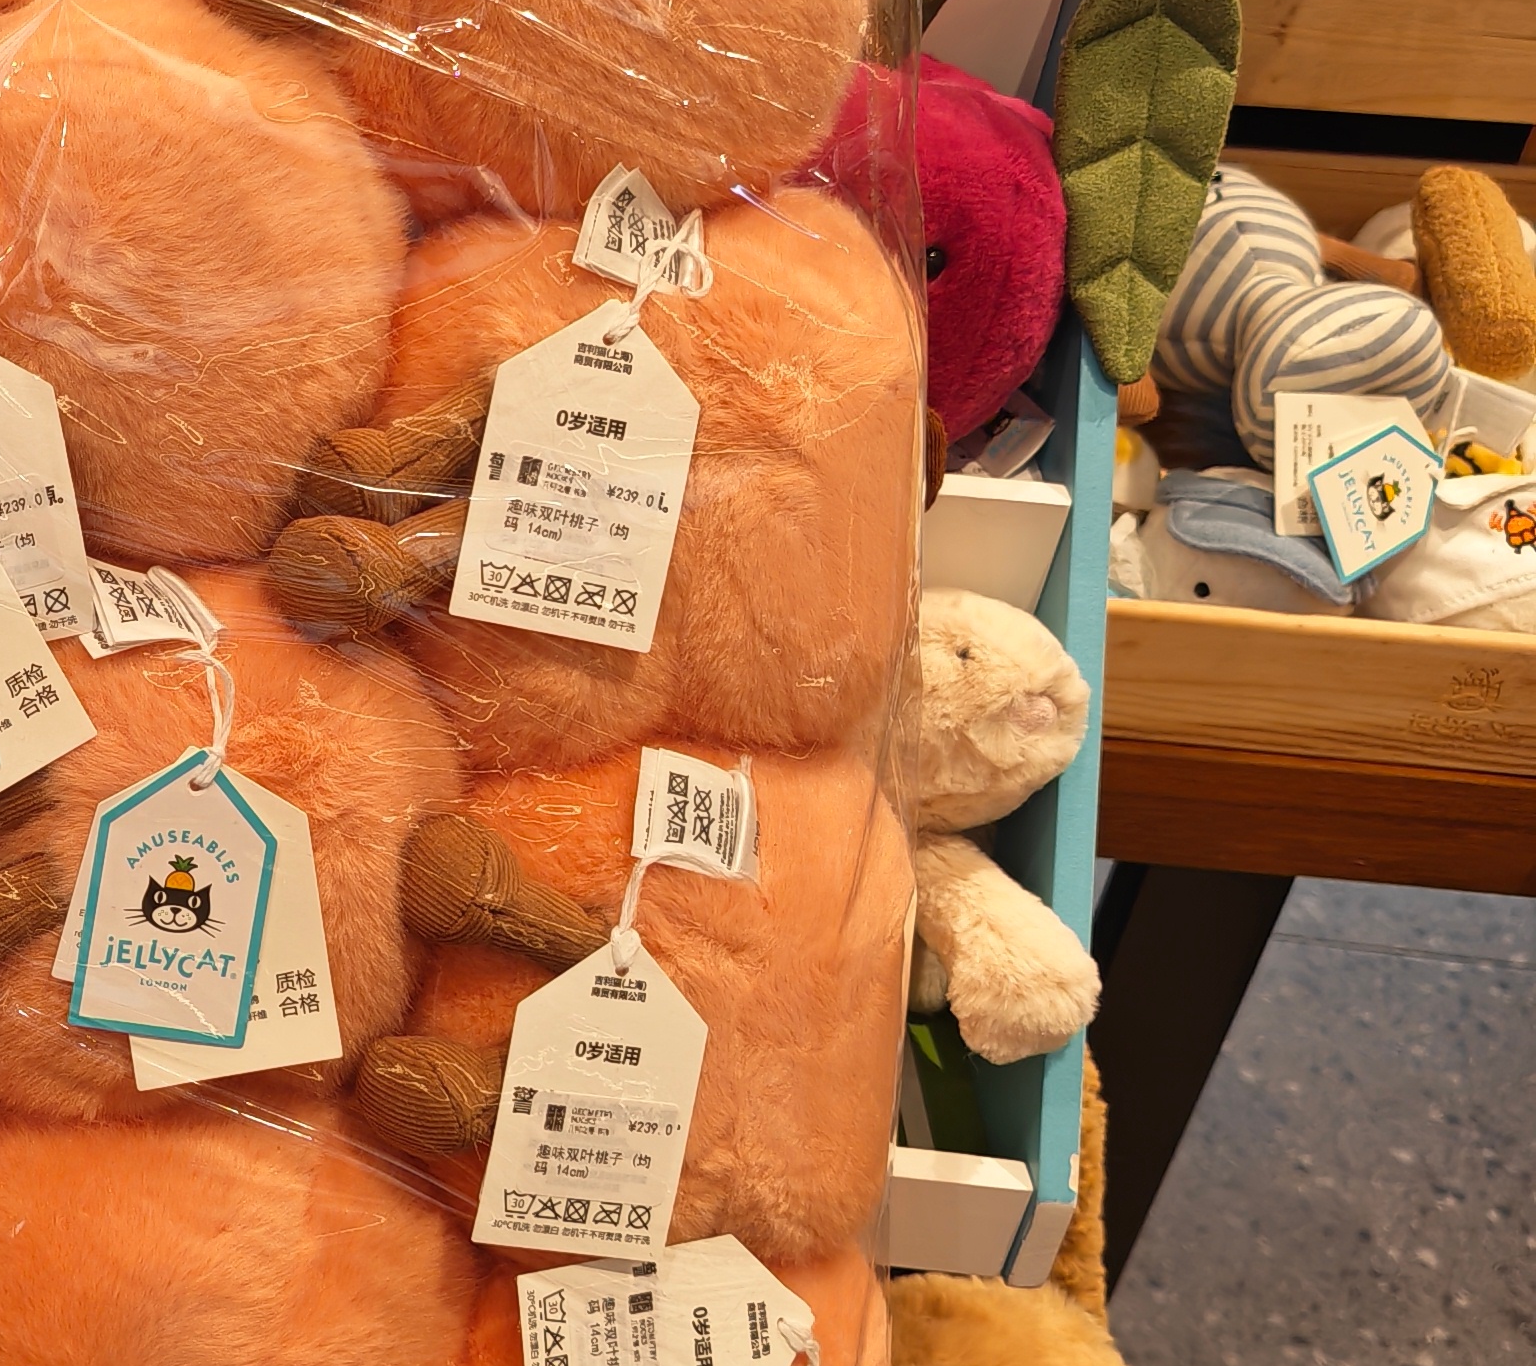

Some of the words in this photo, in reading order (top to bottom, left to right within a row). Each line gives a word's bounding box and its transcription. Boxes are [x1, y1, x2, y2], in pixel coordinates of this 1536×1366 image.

[556, 409, 626, 441] 0岁适用
[5, 662, 48, 698] 质检
[18, 684, 60, 720] 合格
[126, 829, 240, 885] AMUSEABLES
[101, 935, 236, 979] JELLYCAT
[139, 977, 188, 992] LONDON
[275, 968, 317, 994] 质检
[279, 991, 321, 1017] 合格
[574, 1040, 641, 1066] 0岁适用
